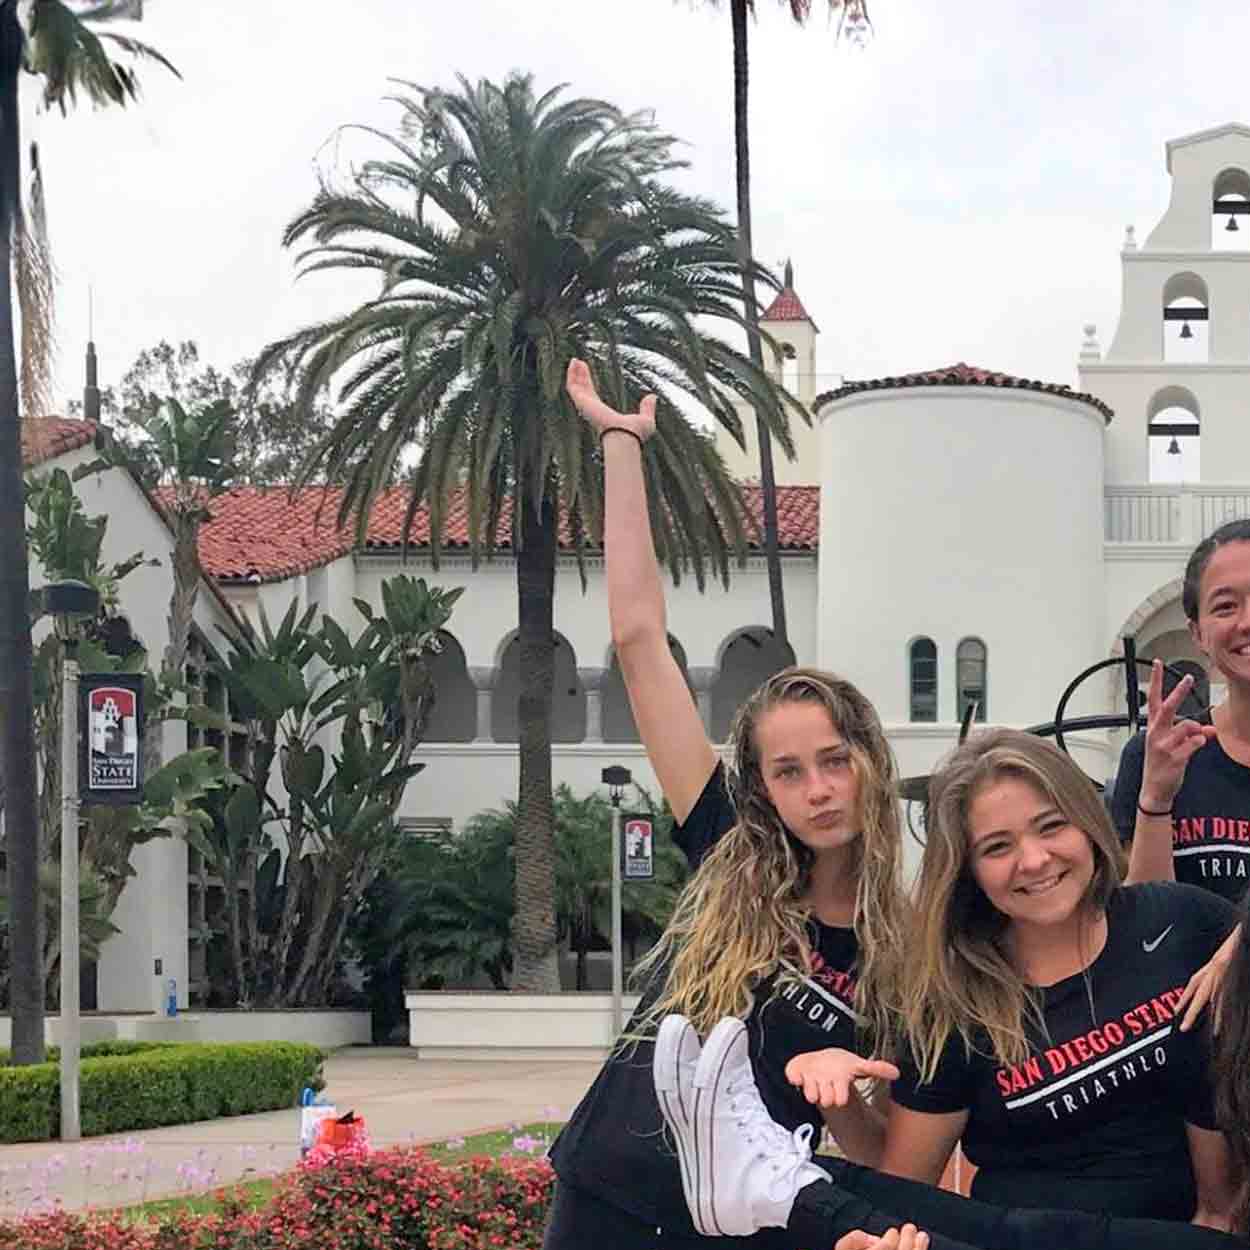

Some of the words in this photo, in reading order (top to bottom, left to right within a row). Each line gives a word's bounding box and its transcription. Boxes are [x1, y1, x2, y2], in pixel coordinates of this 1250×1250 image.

[995, 1056, 1044, 1097] SAN
[1045, 1022, 1125, 1076] DIEGO
[1046, 1046, 1167, 1120] TRIATHLO
